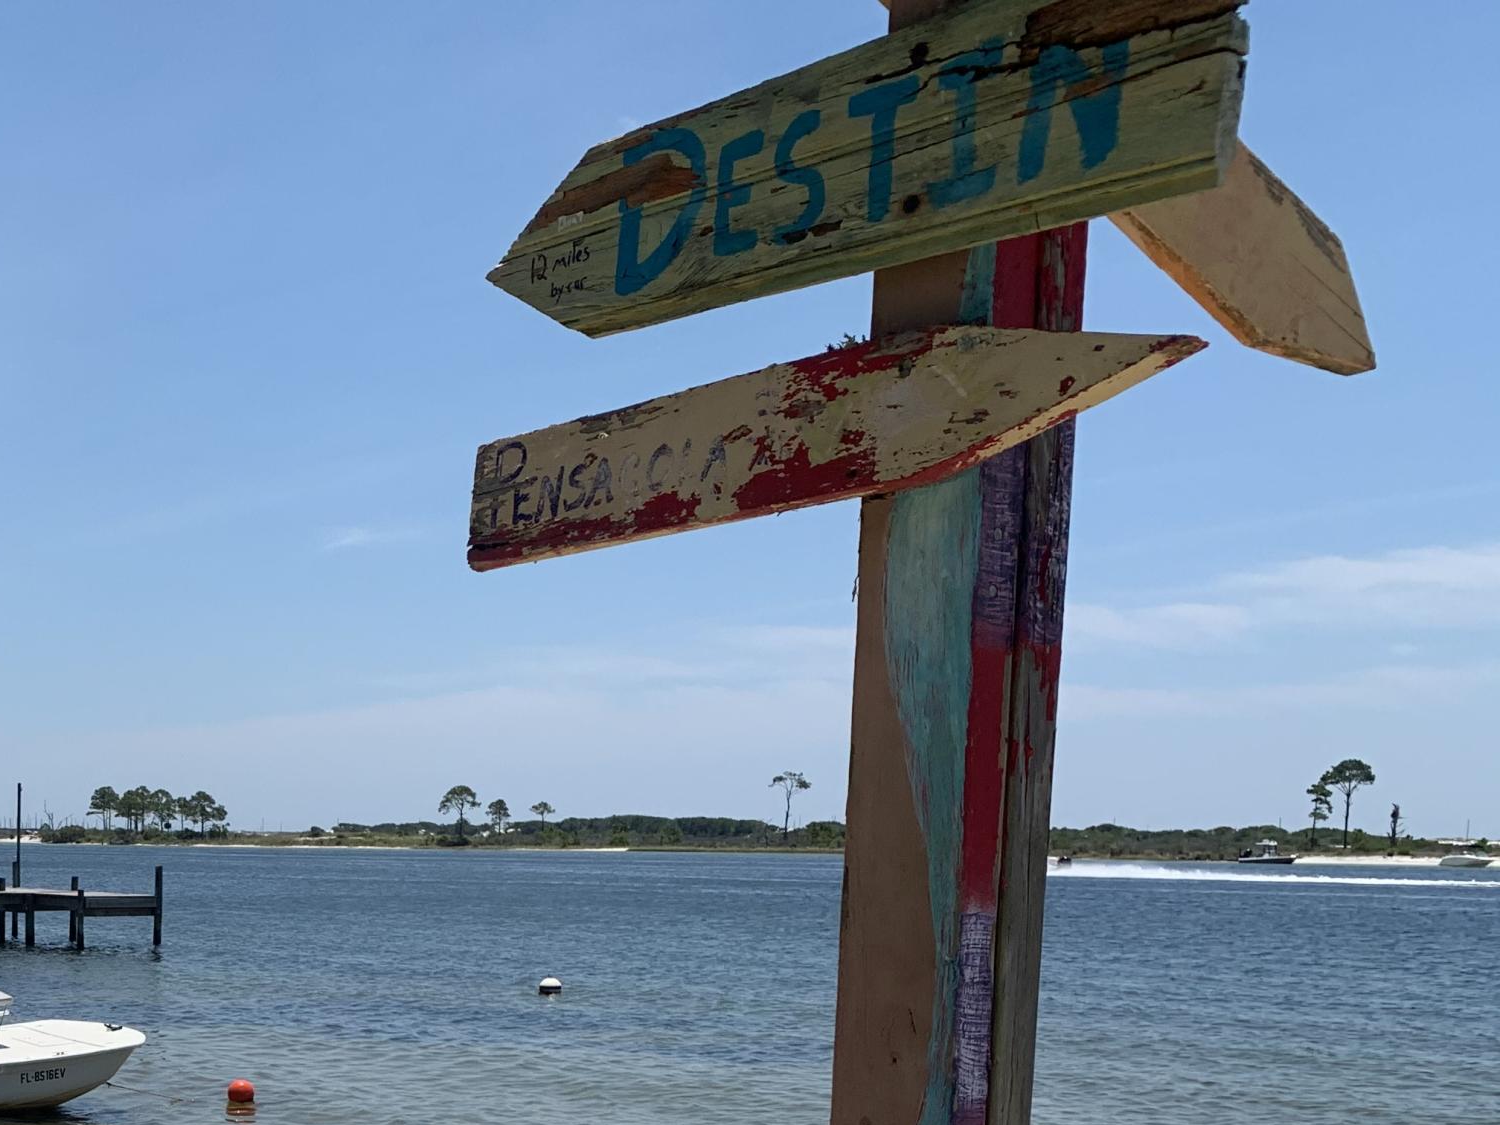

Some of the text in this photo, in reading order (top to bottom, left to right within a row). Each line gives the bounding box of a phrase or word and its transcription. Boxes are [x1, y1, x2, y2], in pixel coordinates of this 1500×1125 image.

[614, 36, 1131, 296] DESTIN
[530, 253, 547, 285] 12
[550, 281, 565, 304] by
